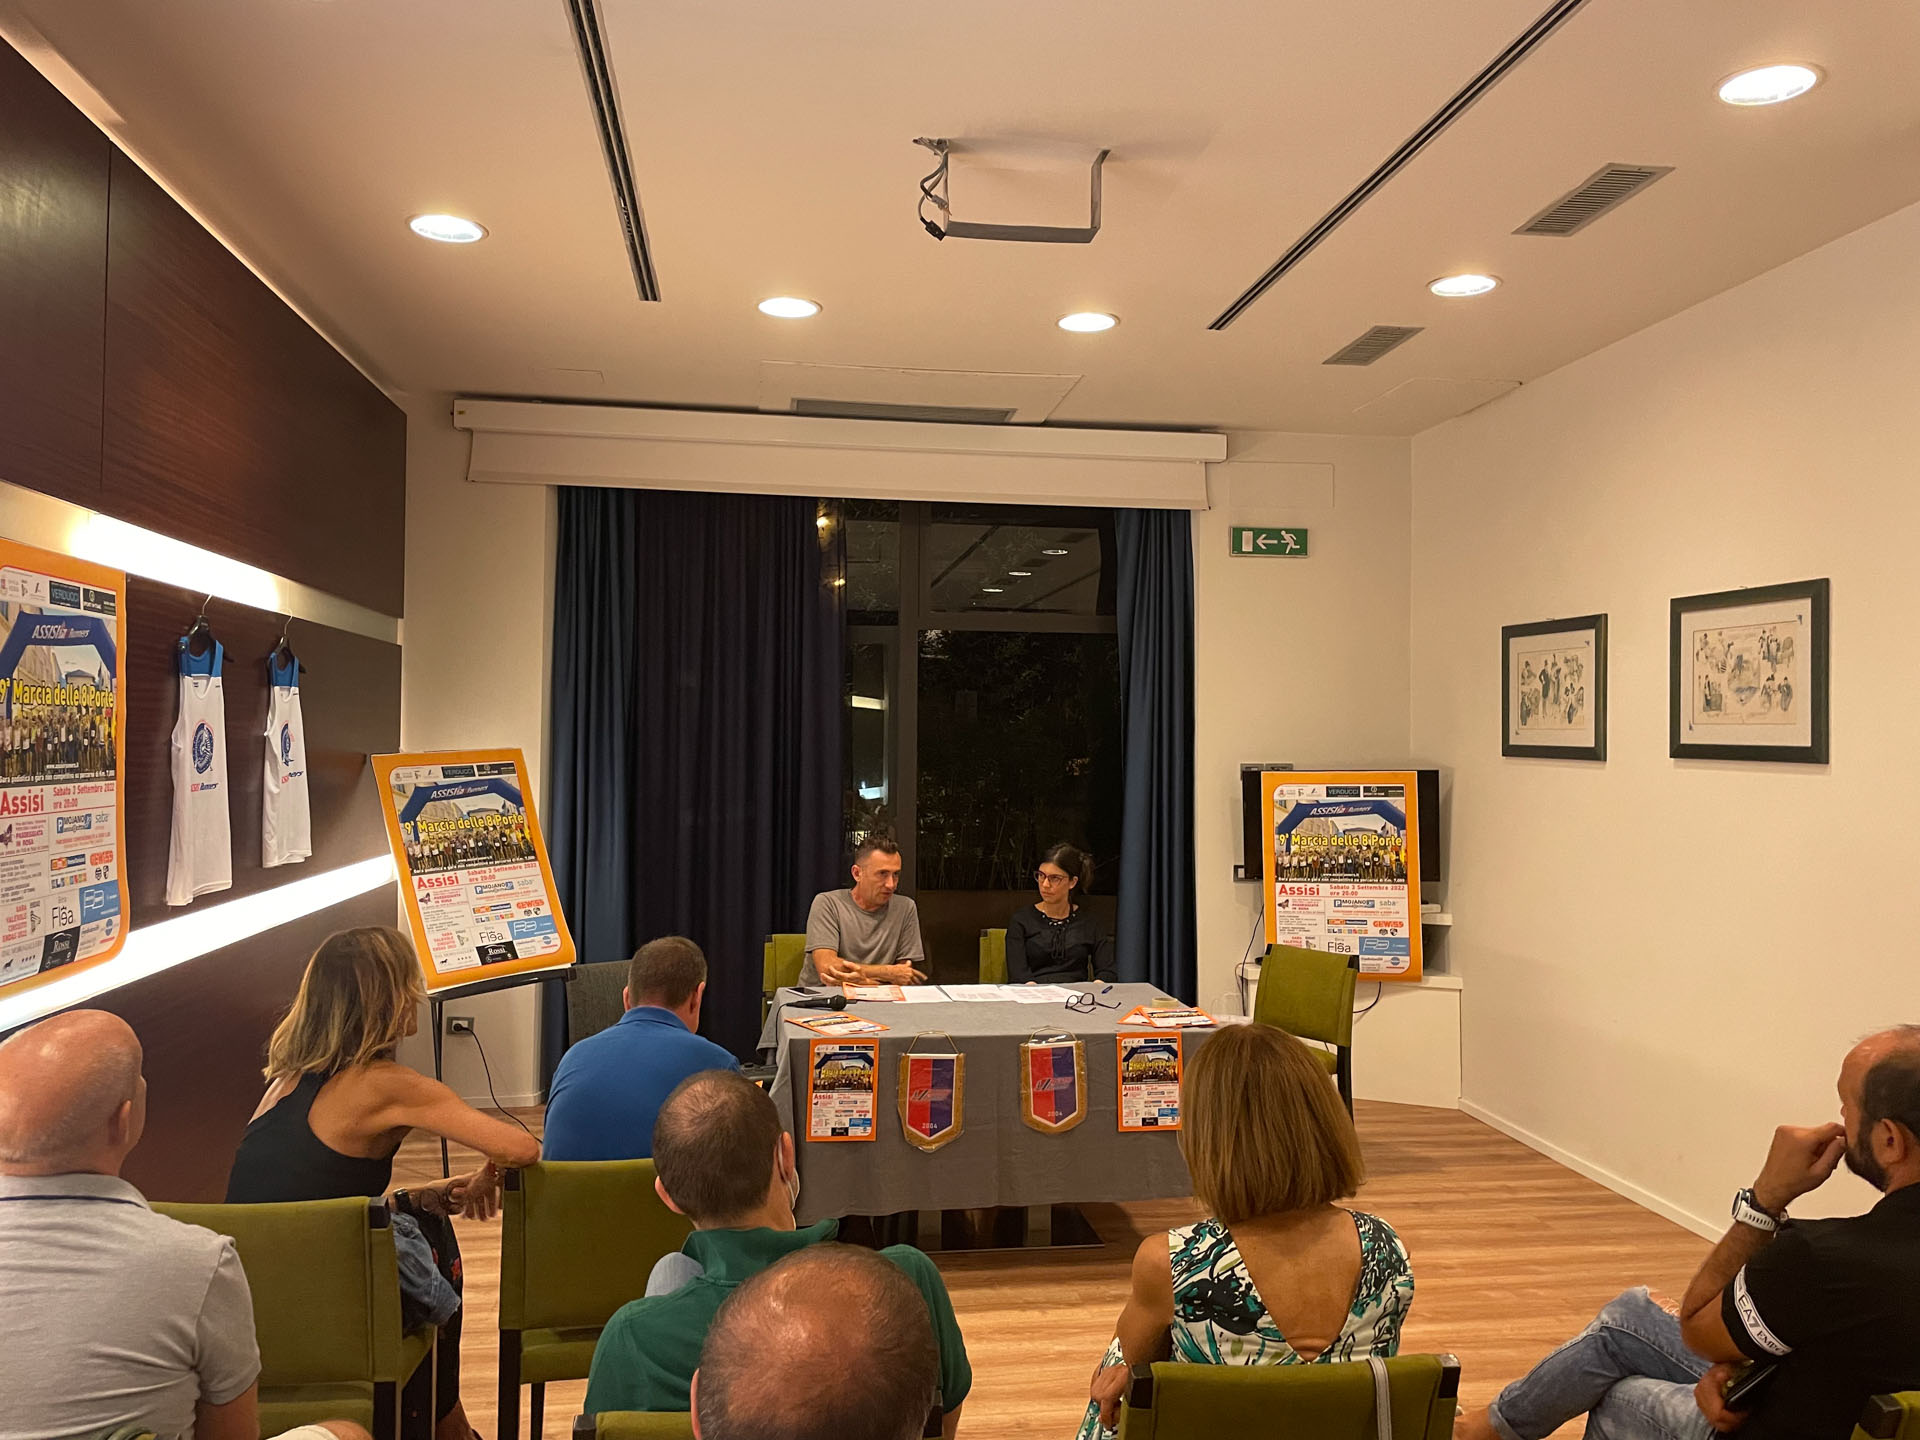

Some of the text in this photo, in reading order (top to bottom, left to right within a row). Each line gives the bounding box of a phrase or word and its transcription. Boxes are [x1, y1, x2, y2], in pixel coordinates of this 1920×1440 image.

[13, 678, 53, 706] Marcia
[54, 681, 80, 707] delle
[82, 683, 89, 708] 8
[89, 684, 114, 709] Porte
[1327, 788, 1359, 796] VERDUCCI
[0, 787, 45, 816] Assisi
[53, 786, 72, 797] Sabato
[77, 782, 103, 795] Settembre
[417, 818, 456, 834] Marcia
[457, 815, 484, 830] delle
[485, 814, 493, 826] 8
[494, 813, 525, 826] Porte
[1291, 834, 1329, 847] Marcia
[1330, 834, 1359, 847] delle
[1360, 834, 1368, 847] 8
[1370, 834, 1403, 847] Porte
[417, 873, 460, 890] Assisi
[467, 868, 487, 877] Sabato
[493, 864, 523, 874] Settembre
[1278, 884, 1320, 897] Assisi
[516, 900, 546, 910] GEWISS
[1373, 920, 1404, 928] GEWISS
[921, 1122, 939, 1130] 2004
[1738, 1294, 1762, 1330] EA7
